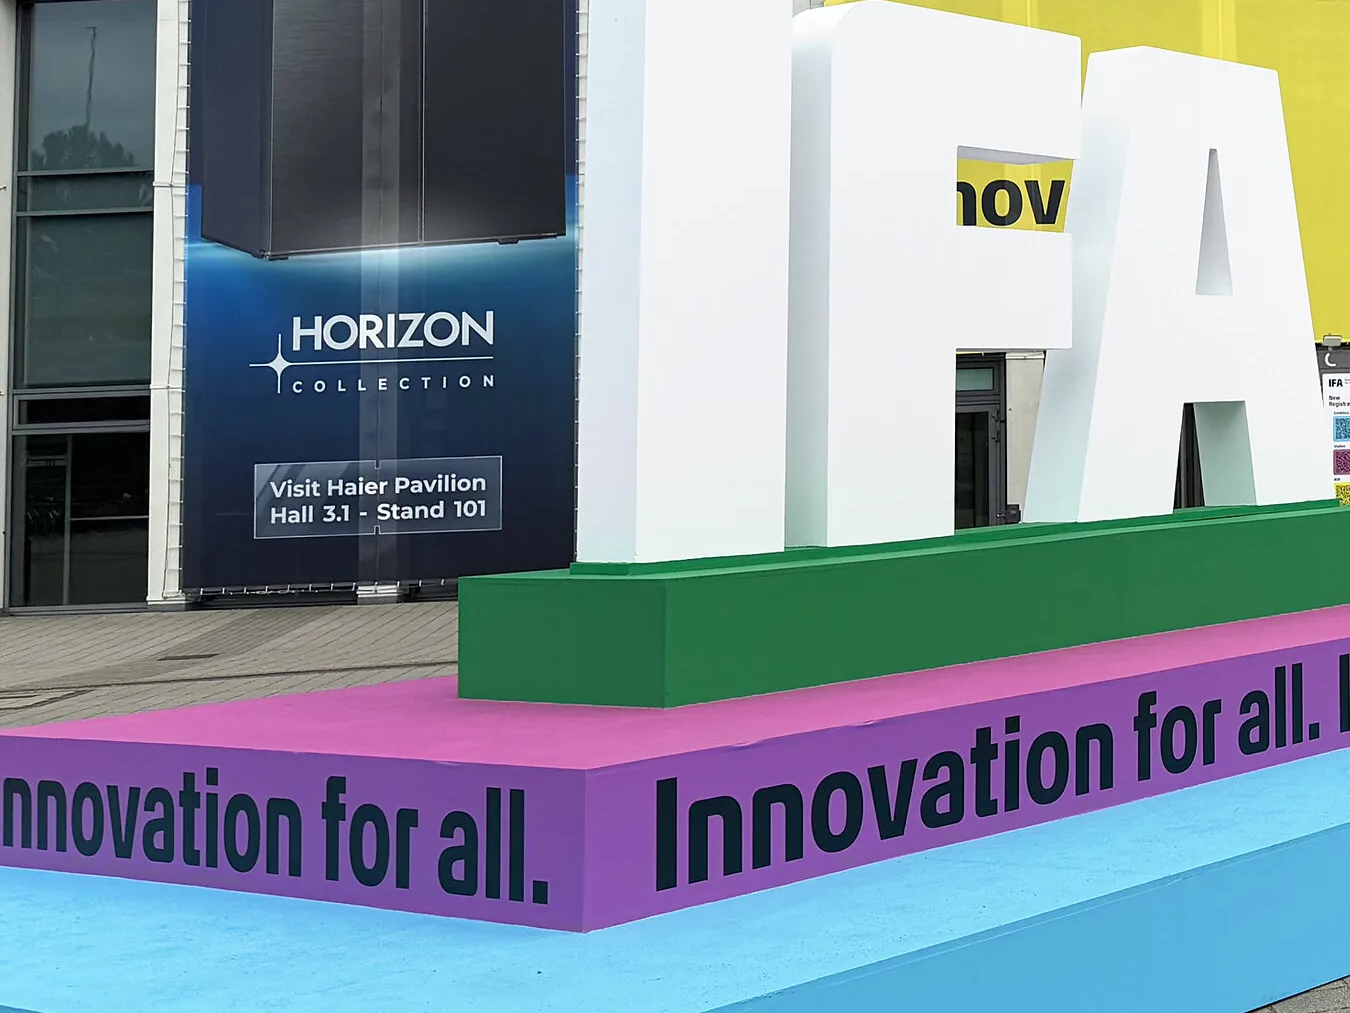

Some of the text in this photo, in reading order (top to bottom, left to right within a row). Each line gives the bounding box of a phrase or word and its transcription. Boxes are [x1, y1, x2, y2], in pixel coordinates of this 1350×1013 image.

[292, 310, 494, 352] HORIZON
[292, 374, 494, 394] COLLECTION
[1328, 378, 1343, 388] IFA
[270, 473, 486, 498] Visit Haier Pavilion
[270, 504, 313, 524] Hall
[323, 504, 350, 523] 3.1
[377, 501, 444, 521] Stand
[454, 499, 486, 518] 101
[655, 714, 1114, 892] Innovation
[1134, 690, 1222, 781] for
[1237, 663, 1320, 757] all.
[322, 775, 419, 891] for
[438, 786, 549, 905] all.
